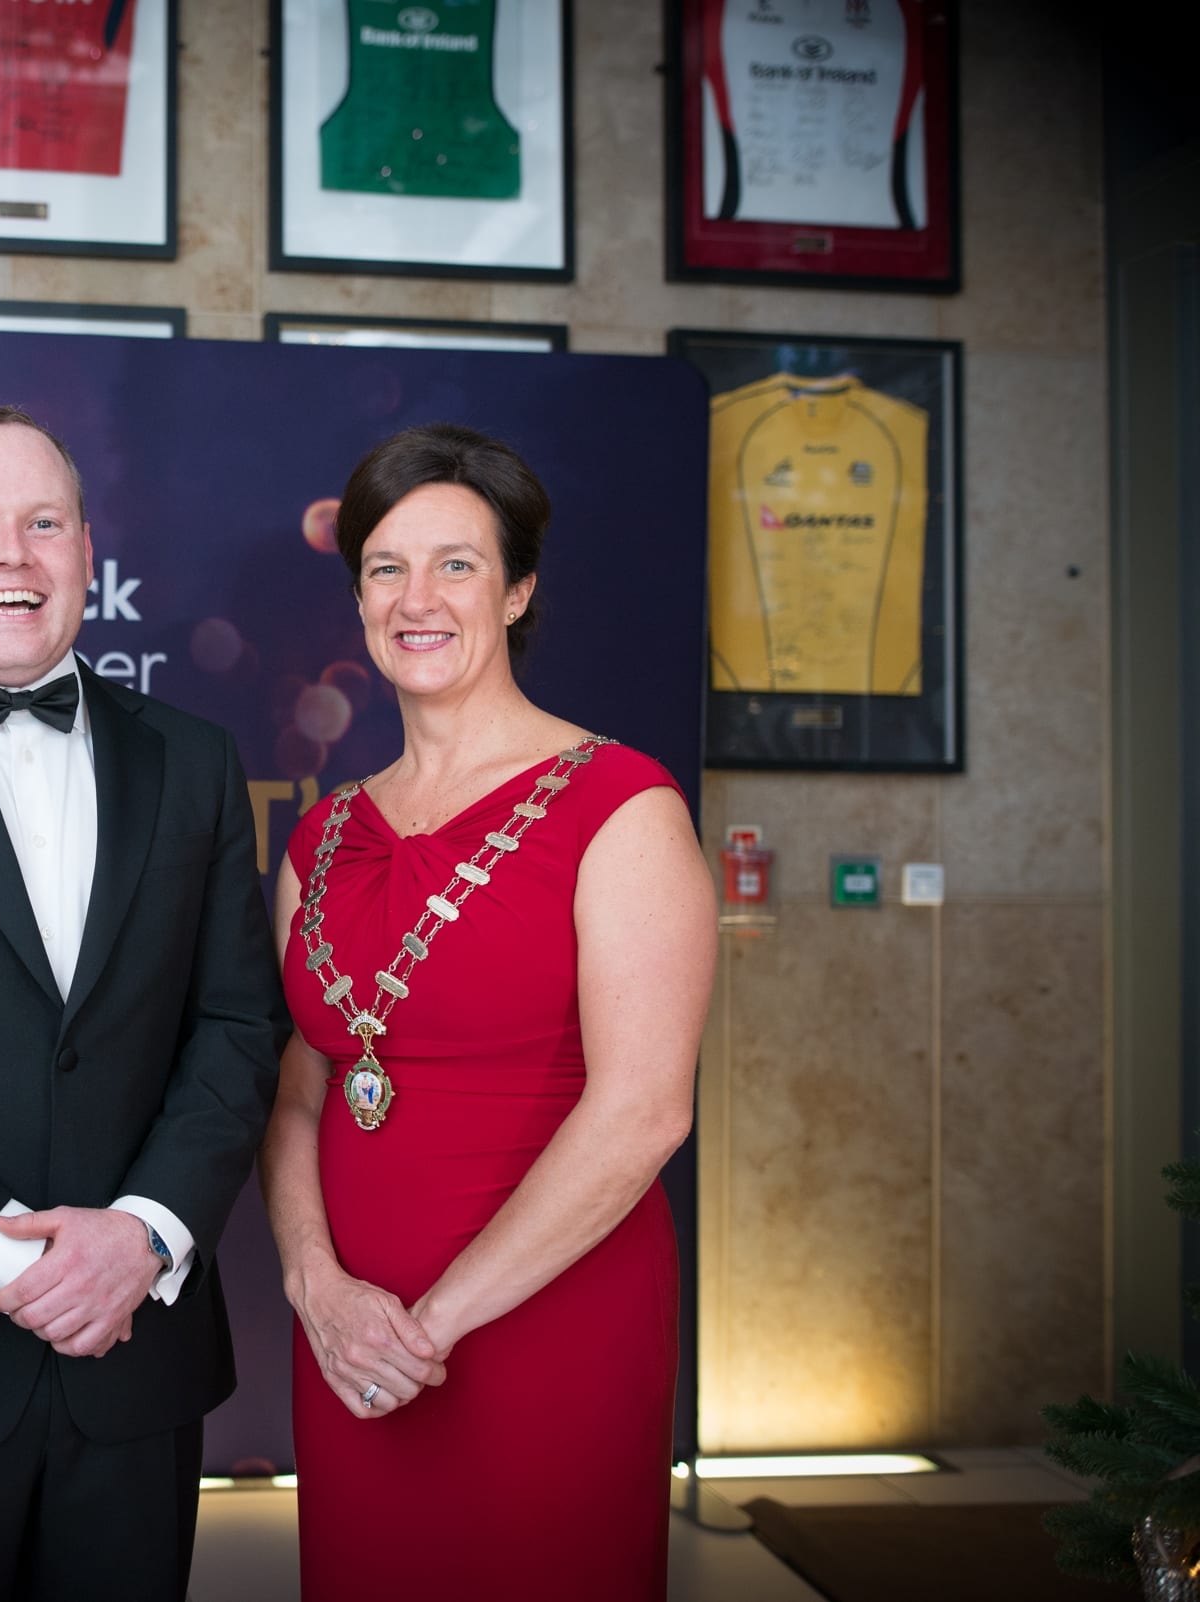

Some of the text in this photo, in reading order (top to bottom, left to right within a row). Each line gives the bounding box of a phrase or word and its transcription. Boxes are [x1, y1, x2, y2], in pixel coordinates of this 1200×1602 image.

[360, 25, 401, 48] Bank
[424, 33, 479, 52] Ireland
[749, 61, 878, 85] Bank of Ireland
